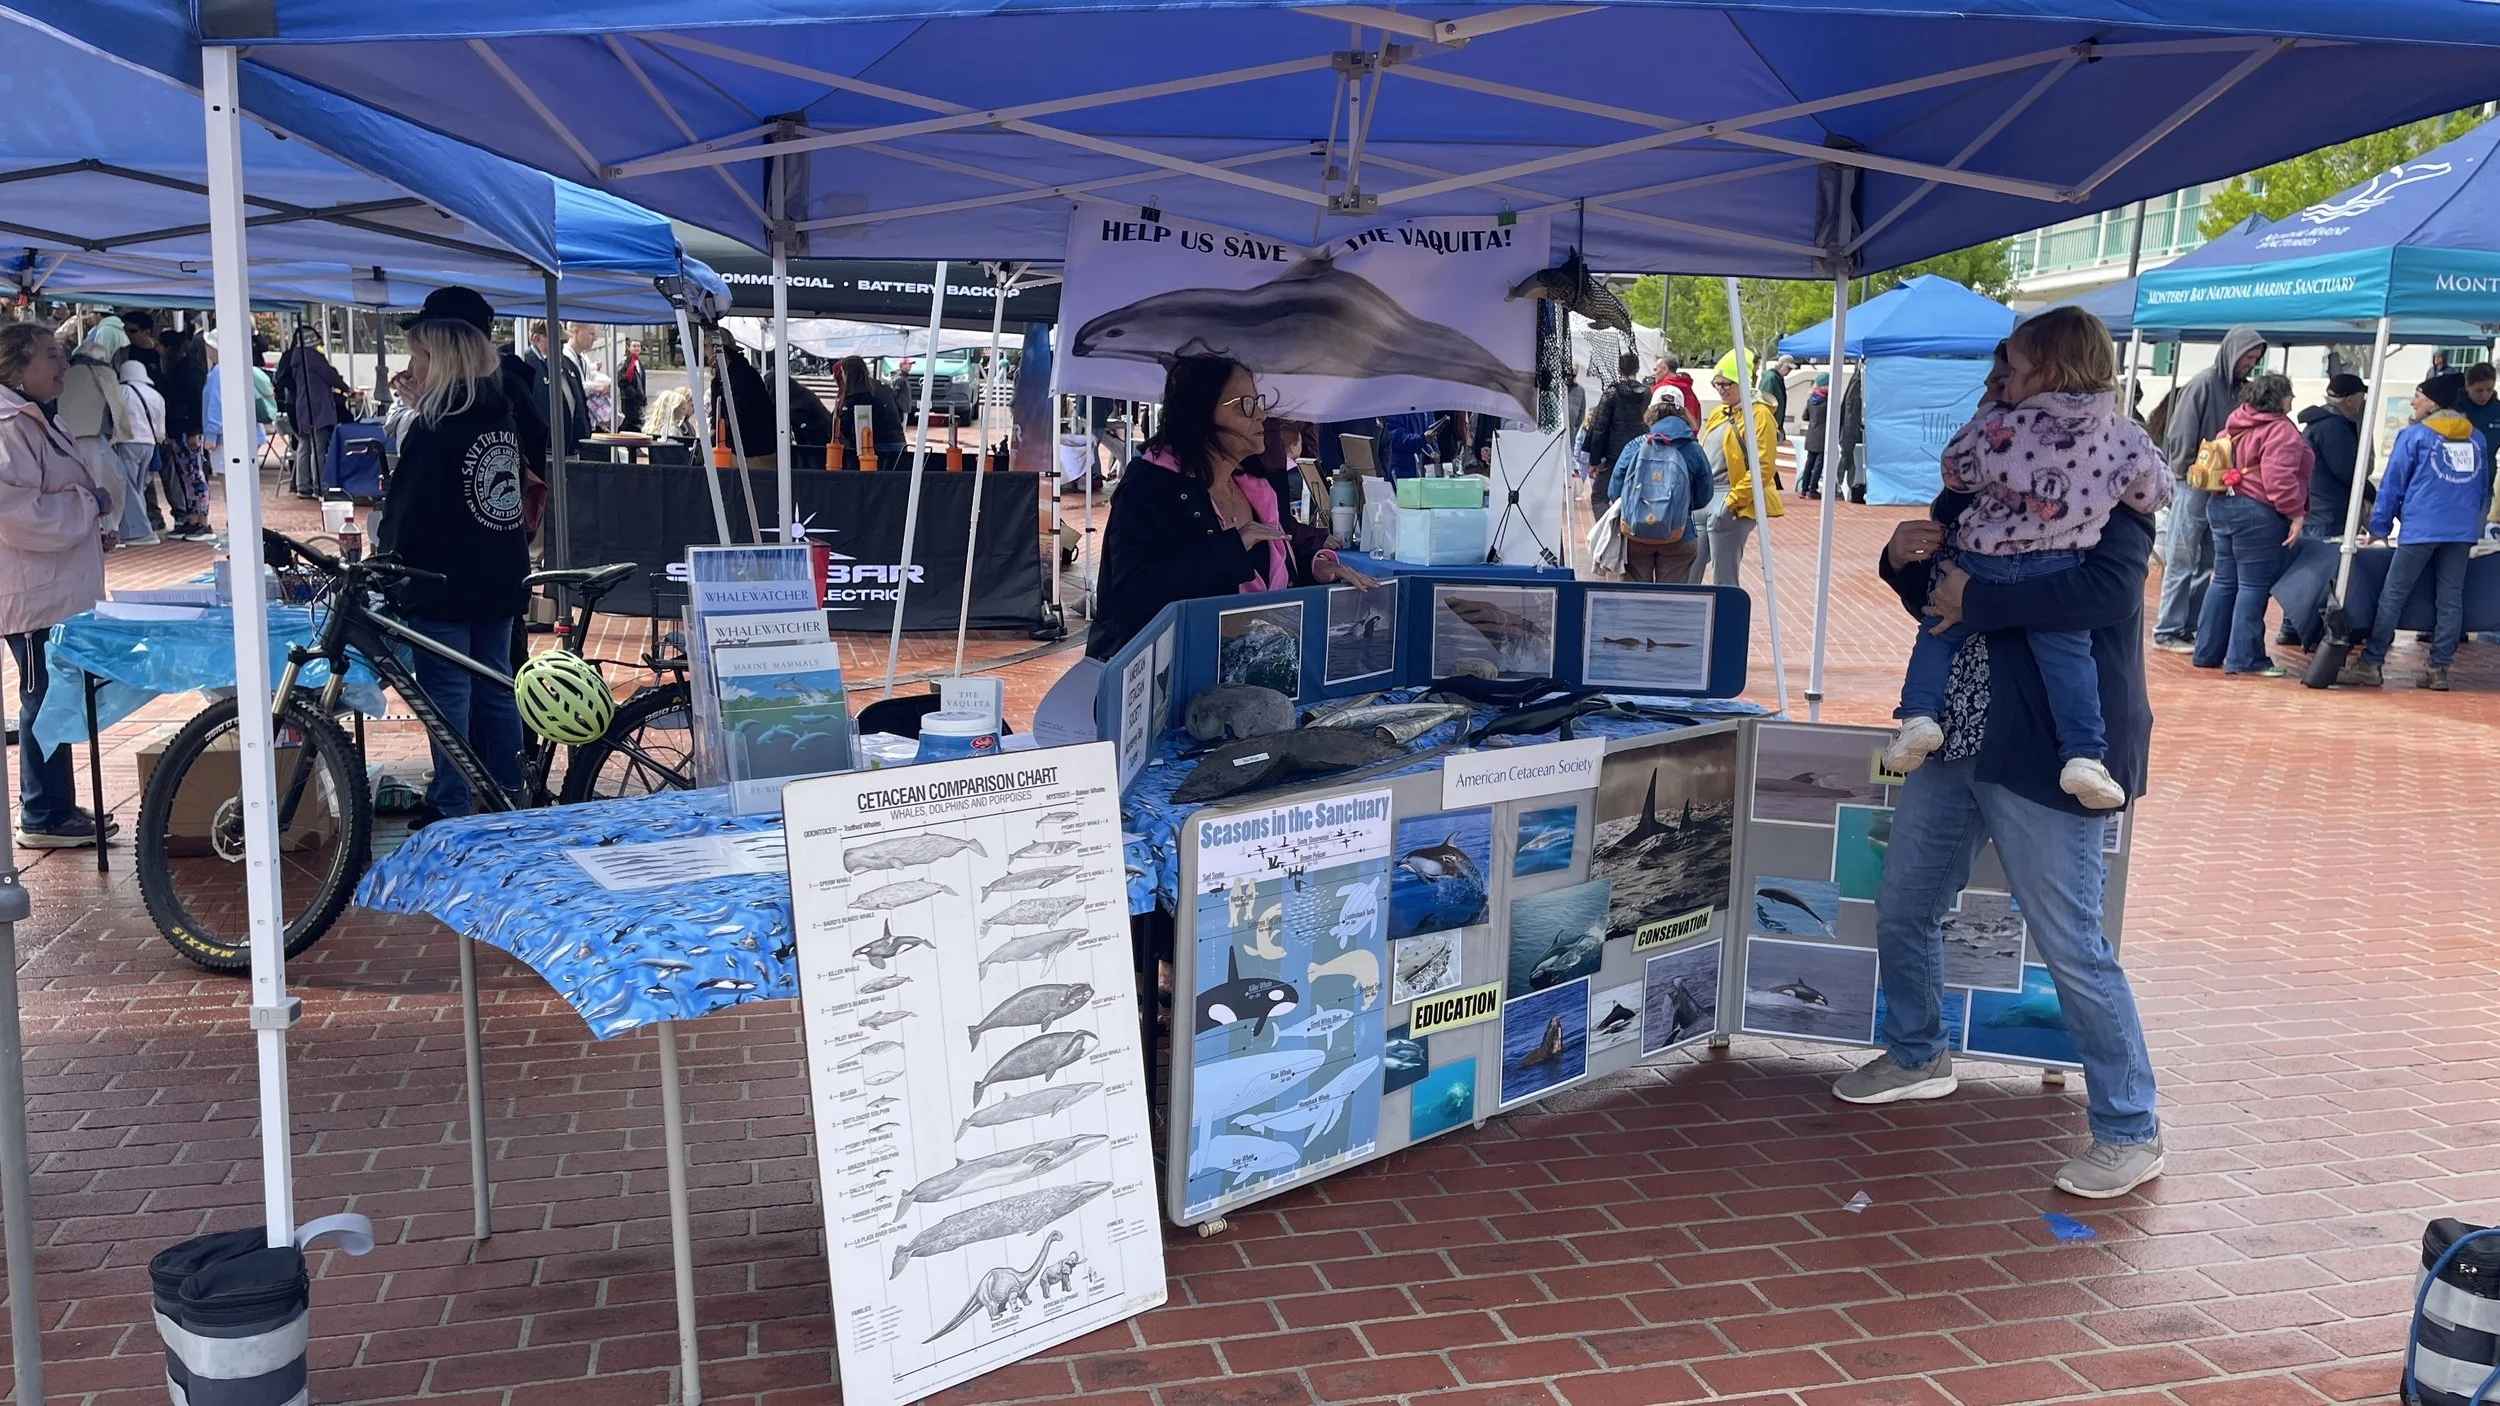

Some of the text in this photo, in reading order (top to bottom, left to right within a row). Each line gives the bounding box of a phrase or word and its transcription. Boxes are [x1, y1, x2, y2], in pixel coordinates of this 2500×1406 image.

[1102, 220, 1171, 242] HELP
[1181, 231, 1214, 253] US
[1223, 236, 1288, 262] SAVE
[1398, 228, 1511, 255] VAQUITA!
[858, 280, 936, 293] BATTERY
[2148, 277, 2356, 304] MONTEREY BAY NATIONAL MARINE SANCTUARY
[462, 443, 483, 476] SAVE
[477, 431, 499, 448] THE
[705, 590, 808, 602] WHALEWATCHER
[715, 622, 821, 637] WHALEWATCHER
[734, 660, 819, 671] MARINE MAMMALS
[947, 700, 990, 708] VAQUITA
[1456, 757, 1594, 788] American Cetacean Society
[858, 767, 1058, 811] CETACEAN COMPARISON CHART
[890, 790, 1032, 821] WHALES, DOLPHINS AND PORPOISES
[804, 827, 837, 838] ODONTOCETI
[1200, 796, 1390, 849] Seasons in the Sanctuary
[172, 927, 236, 957] MAXXIS
[1638, 912, 1710, 947] CONSERVATION
[828, 965, 860, 977] KILLER WHALE
[1415, 989, 1497, 1030] EDUCATION
[835, 1035, 847, 1043] PILOT
[848, 1031, 863, 1039] WHALE
